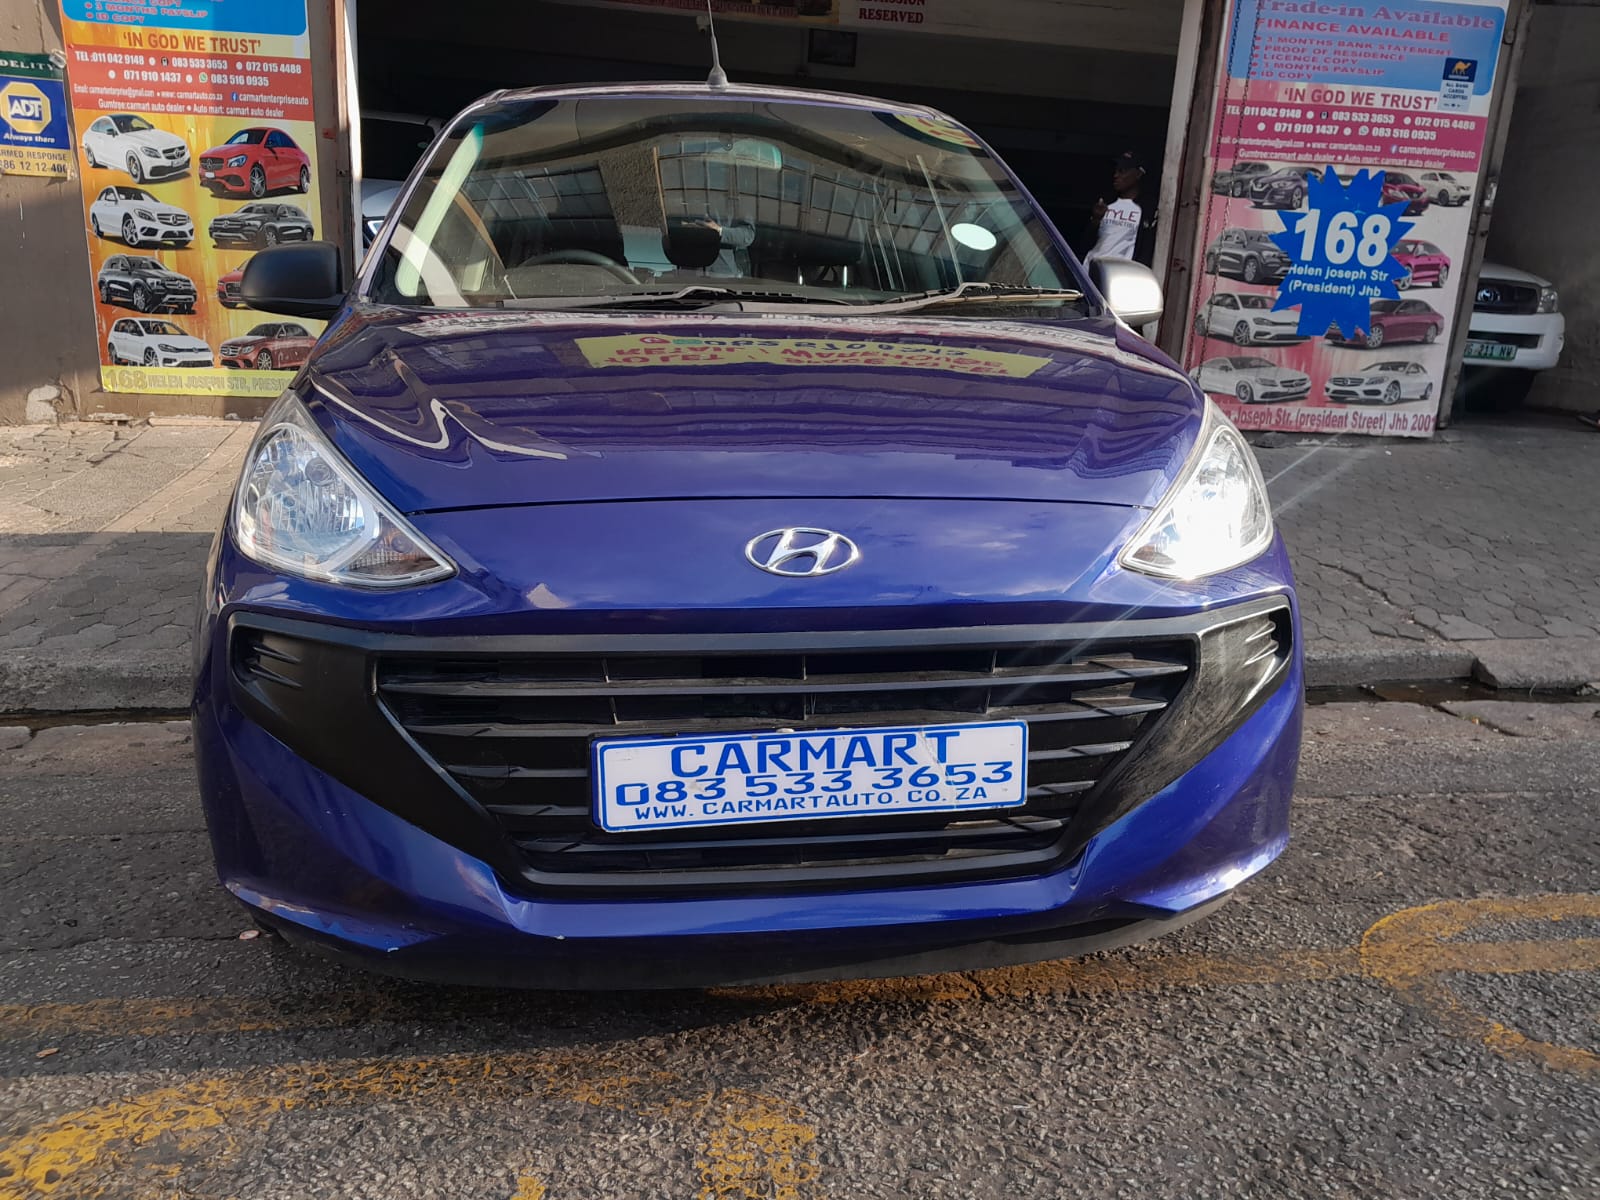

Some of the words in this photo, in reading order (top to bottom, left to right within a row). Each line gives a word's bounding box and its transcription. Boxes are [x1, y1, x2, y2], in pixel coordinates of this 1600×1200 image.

[96, 12, 107, 20] ID
[111, 14, 144, 23] COPY
[105, 4, 156, 14] MONTHS
[160, 8, 207, 18] PAYSLIP
[859, 8, 924, 24] RESERVED
[1372, 7, 1494, 29] Available
[1257, 18, 1340, 32] FINANCE
[1347, 25, 1449, 41] AVAILABLE
[149, 34, 178, 49] GOD
[184, 36, 205, 51] WE
[1277, 37, 1333, 46] MONTHS
[1338, 41, 1372, 49] BANK
[1378, 44, 1452, 56] STATEMENT
[1263, 54, 1319, 62] LICENCE
[1324, 57, 1358, 65] COPY
[1264, 45, 1309, 53] PROOF
[1333, 50, 1405, 60] RESIDENCE
[75, 51, 89, 61] TEL
[107, 53, 123, 63] 042
[125, 55, 144, 65] 9148
[172, 57, 188, 67] 083
[189, 58, 205, 68] 533
[206, 59, 227, 69] 3653
[246, 62, 261, 71] 072
[263, 62, 278, 72] 015
[280, 64, 301, 74] 4488
[1274, 63, 1329, 72] MONTHS
[1334, 67, 1384, 76] PAYSLIP
[124, 70, 139, 80] 071
[141, 71, 158, 81] 910
[160, 72, 181, 82] 1437
[211, 74, 228, 84] 083
[229, 75, 244, 85] 516
[246, 76, 269, 86] 0935
[1311, 89, 1345, 103] GOD
[1351, 91, 1375, 106] WE
[10, 98, 42, 118] ADT
[1260, 107, 1278, 117] 042
[1279, 108, 1301, 118] 9148
[1332, 111, 1349, 121] 083
[1352, 112, 1369, 122] 533
[1371, 113, 1395, 124] 3653
[1414, 117, 1432, 127] 072
[1433, 118, 1450, 128] 015
[4, 133, 32, 142] Always
[35, 135, 55, 143] there
[1274, 122, 1292, 132] 071
[1294, 123, 1313, 133] 910
[1316, 125, 1339, 134] 1437
[1372, 127, 1391, 137] 083
[1393, 128, 1410, 138] 516
[1411, 129, 1437, 140] 0935
[27, 152, 65, 160] RESPONSE
[0, 160, 15, 169] 86
[20, 161, 31, 171] 12
[35, 162, 47, 172] 12
[1295, 208, 1391, 267] 168
[1288, 264, 1322, 276] Helen
[1371, 270, 1389, 281] Str
[1289, 279, 1355, 297] (President)
[1358, 284, 1382, 297] Jhb
[106, 369, 147, 389] 168
[1234, 408, 1271, 427] Joseph
[1275, 409, 1292, 426] Str.
[1296, 410, 1348, 430] (president
[1351, 411, 1387, 434] Street)
[1389, 412, 1408, 430] Jhb
[1410, 414, 1437, 433] 2001
[671, 731, 960, 778] CARMART
[616, 777, 726, 806] 083
[746, 770, 852, 797] 533
[872, 761, 1012, 790] 3653
